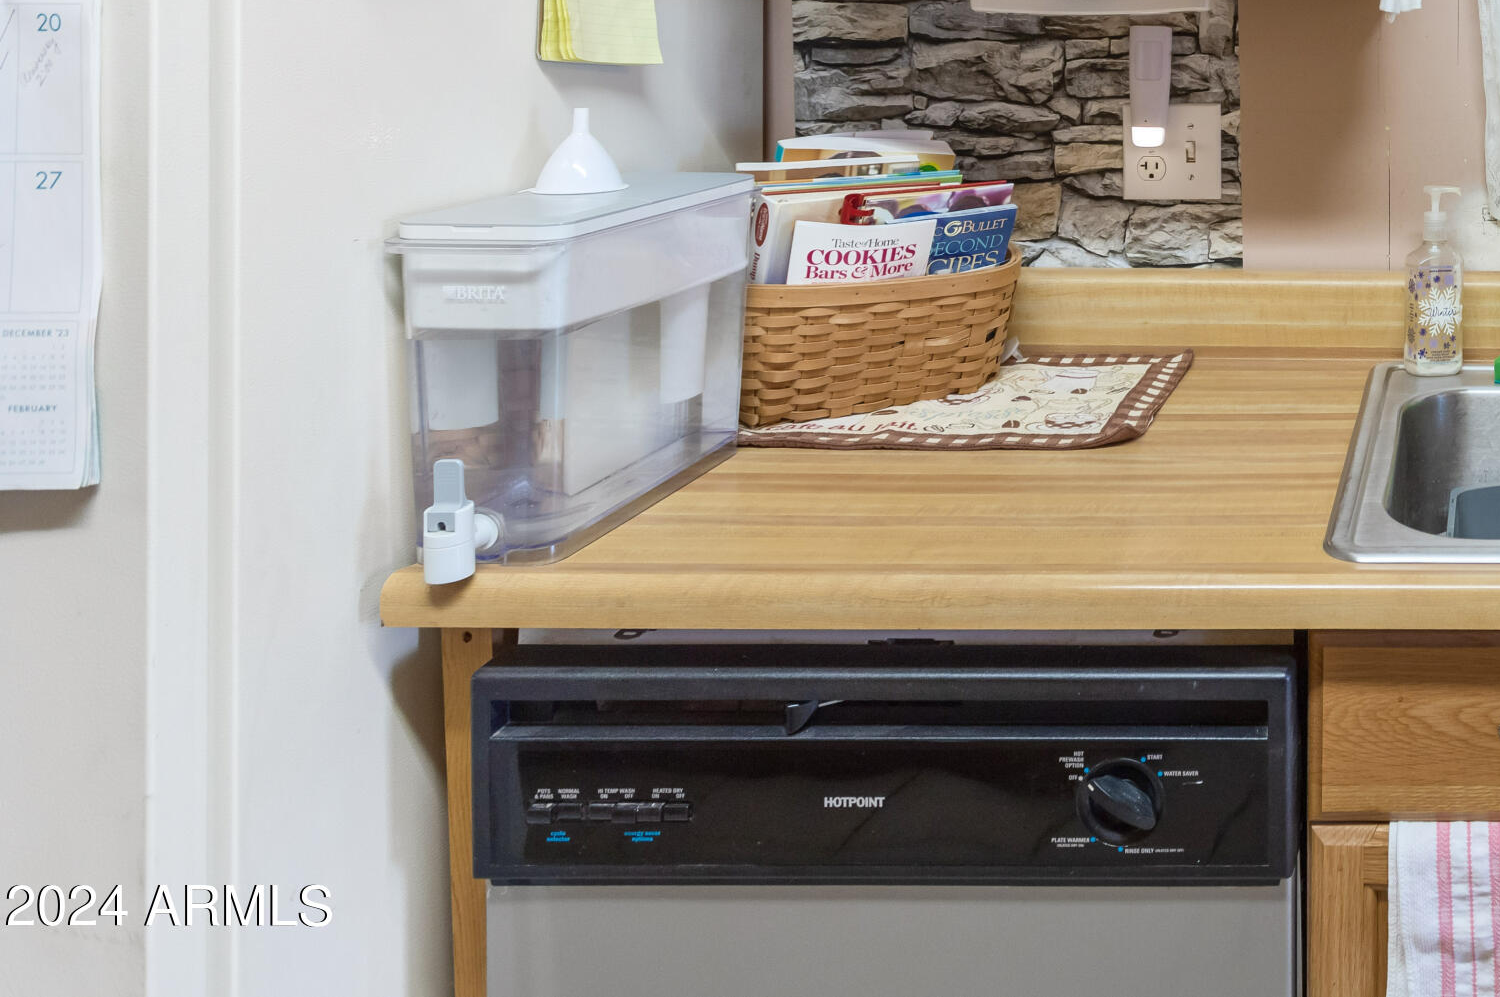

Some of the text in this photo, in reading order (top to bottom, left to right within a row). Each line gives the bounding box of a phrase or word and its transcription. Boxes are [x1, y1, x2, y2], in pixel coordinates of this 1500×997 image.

[37, 13, 61, 32] 20
[36, 171, 62, 190] 27
[832, 238, 860, 248] Taste
[868, 238, 899, 248] Home
[806, 243, 917, 266] COOKIES
[805, 262, 913, 280] Bars & More
[455, 285, 505, 300] BRITA
[2, 329, 52, 337] DECEMBER
[8, 405, 57, 413] FEBRUARY
[823, 796, 886, 808] HOTPOINT
